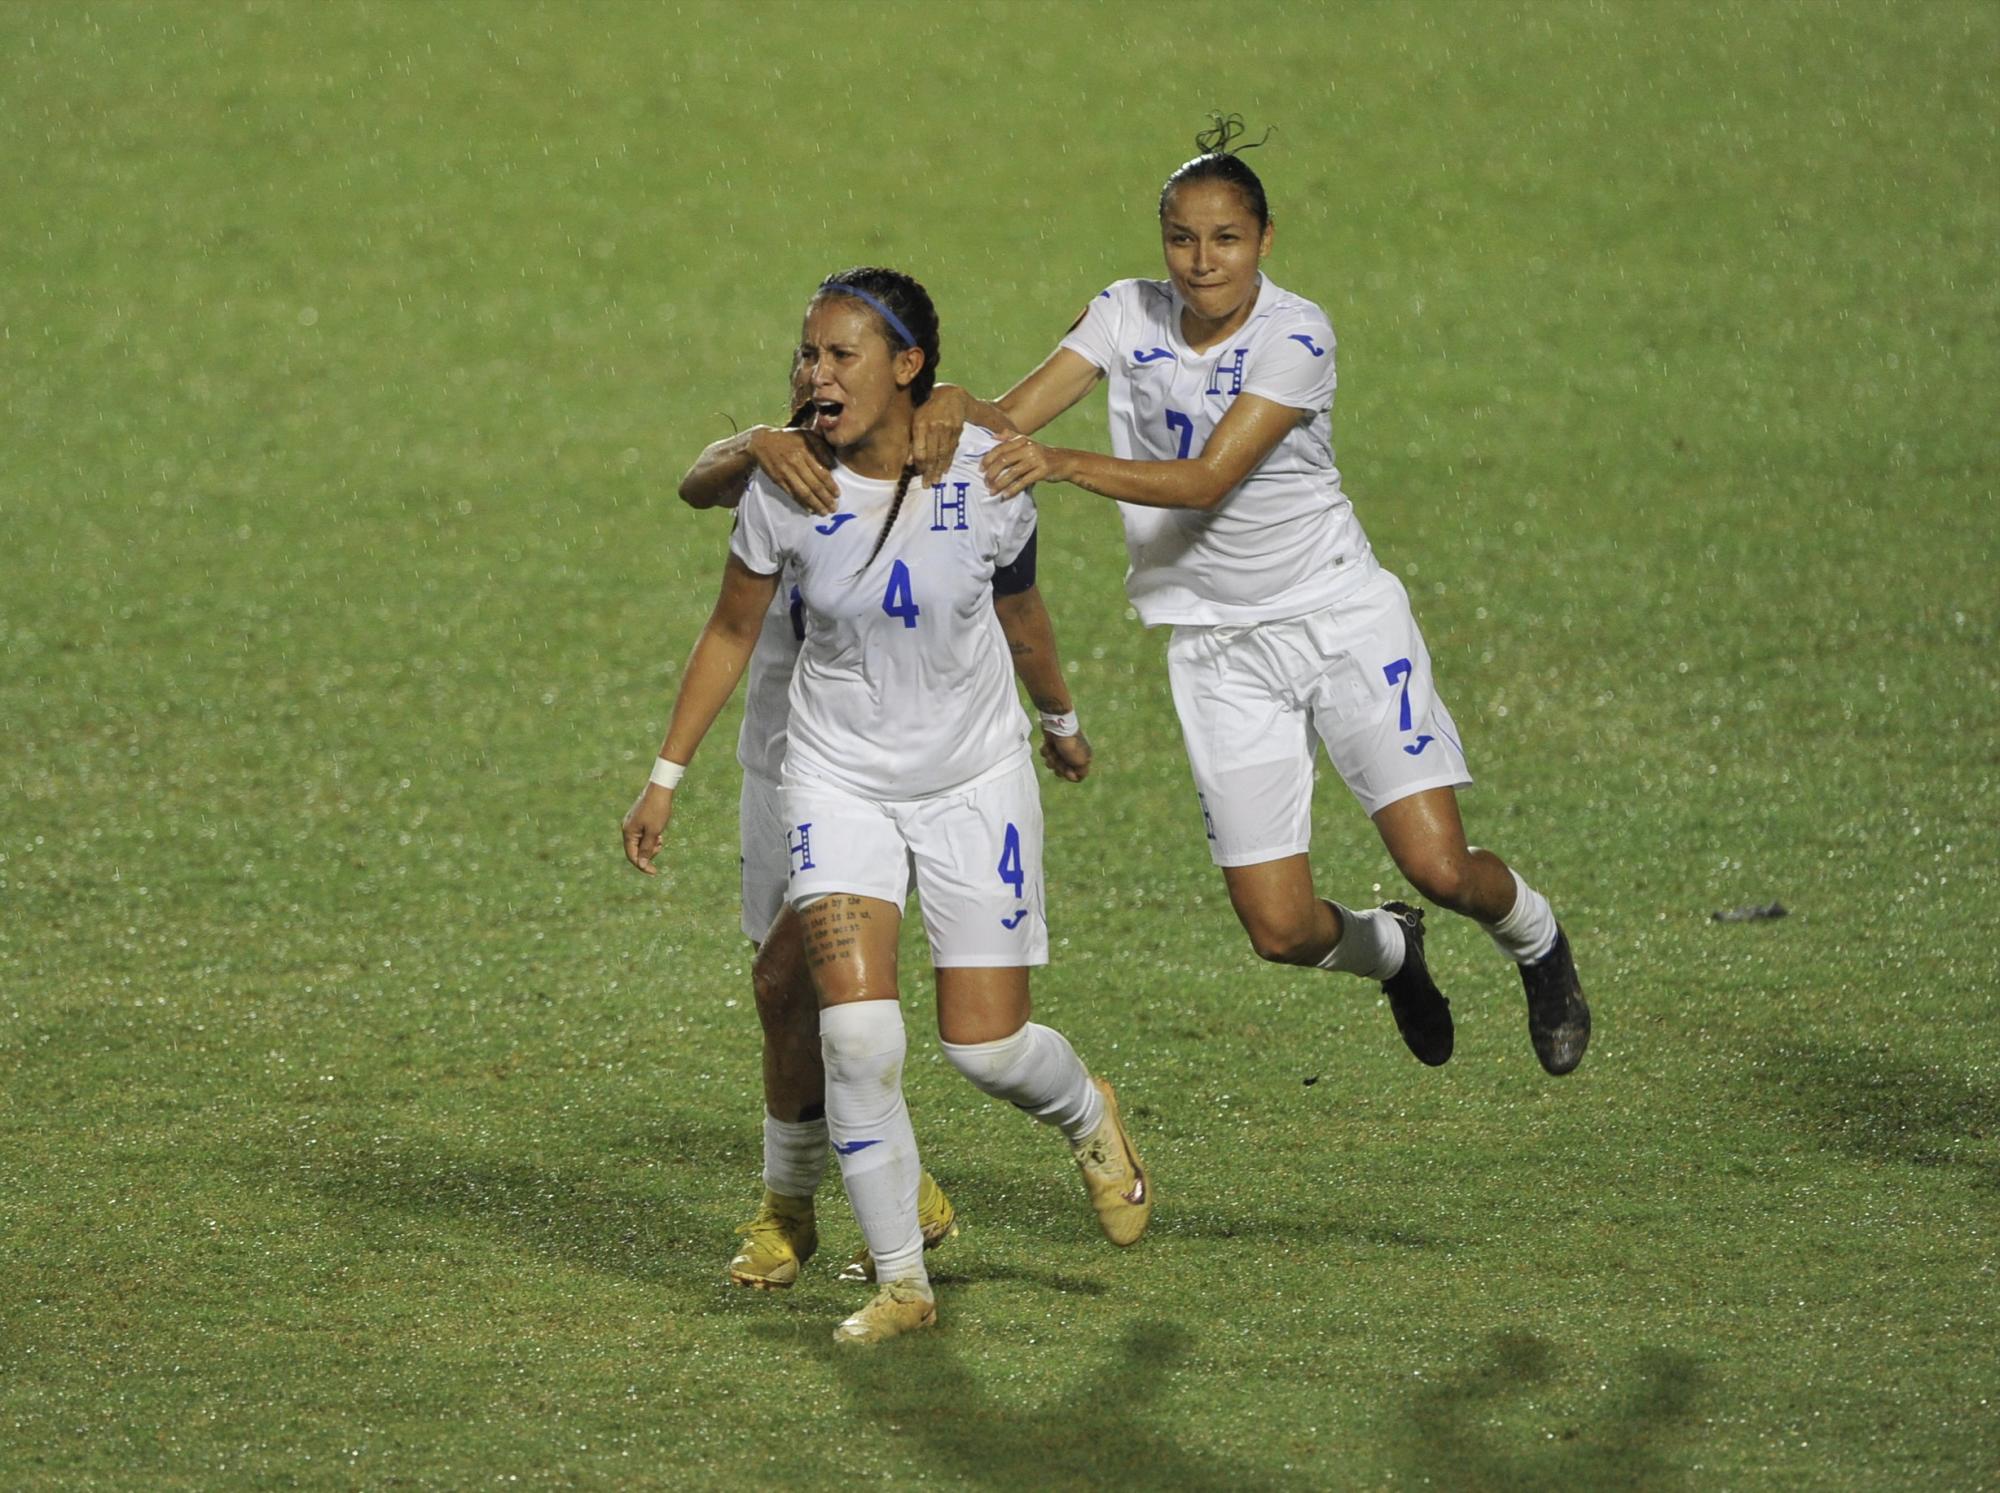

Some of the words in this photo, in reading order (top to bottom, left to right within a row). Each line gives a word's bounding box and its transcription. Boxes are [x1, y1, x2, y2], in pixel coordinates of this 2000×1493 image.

[1206, 349, 1249, 395] H
[1165, 408, 1193, 459] 7
[930, 482, 970, 531] H
[882, 559, 920, 628] 4
[1382, 658, 1412, 732] 7
[997, 822, 1024, 899] 4
